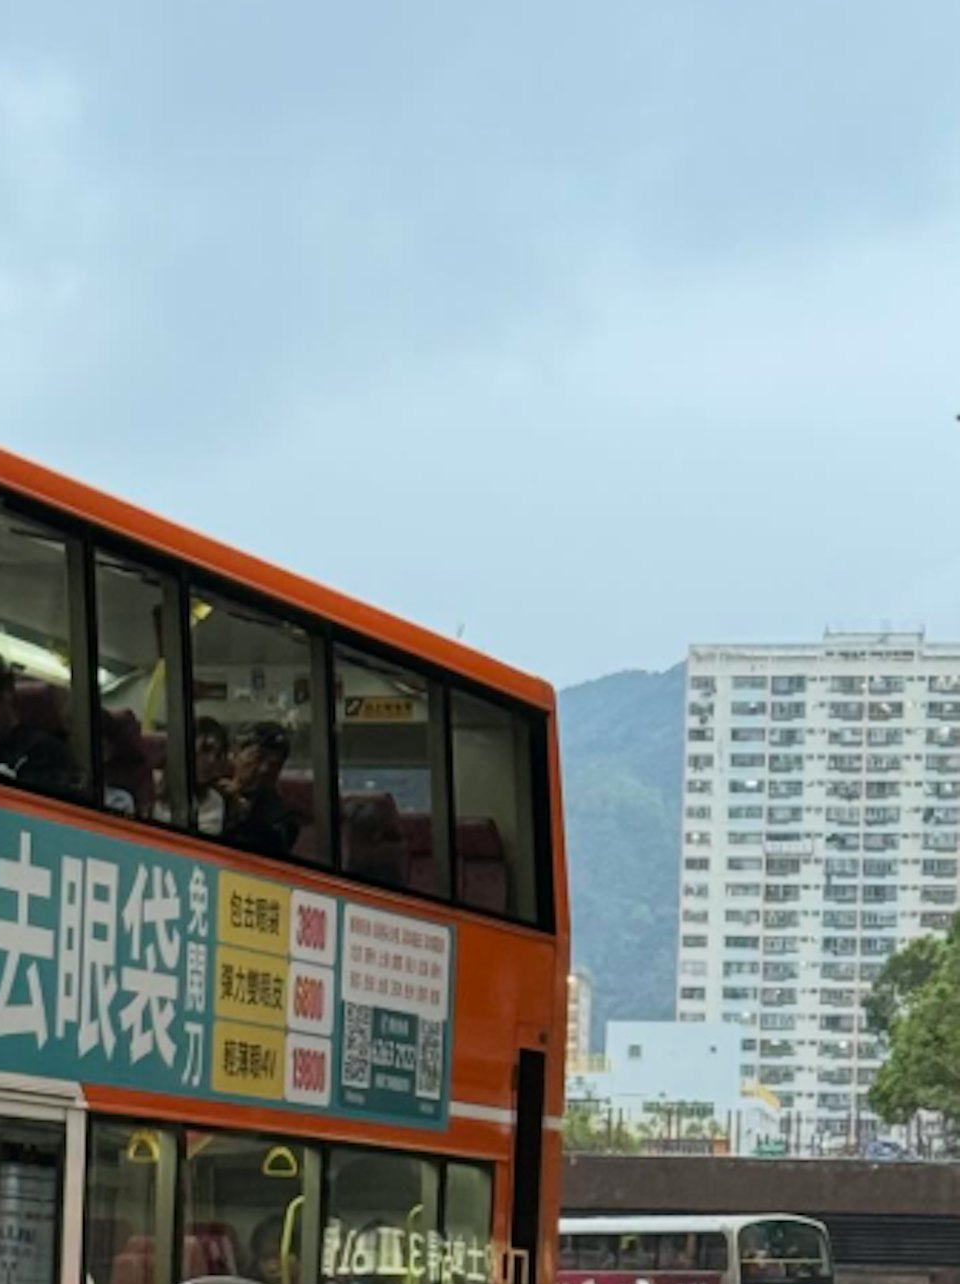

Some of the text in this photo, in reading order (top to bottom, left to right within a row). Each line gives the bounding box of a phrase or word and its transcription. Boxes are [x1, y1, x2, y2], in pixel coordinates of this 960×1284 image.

[181, 866, 208, 1086] 免開刀
[230, 890, 280, 936] 包去眼袋
